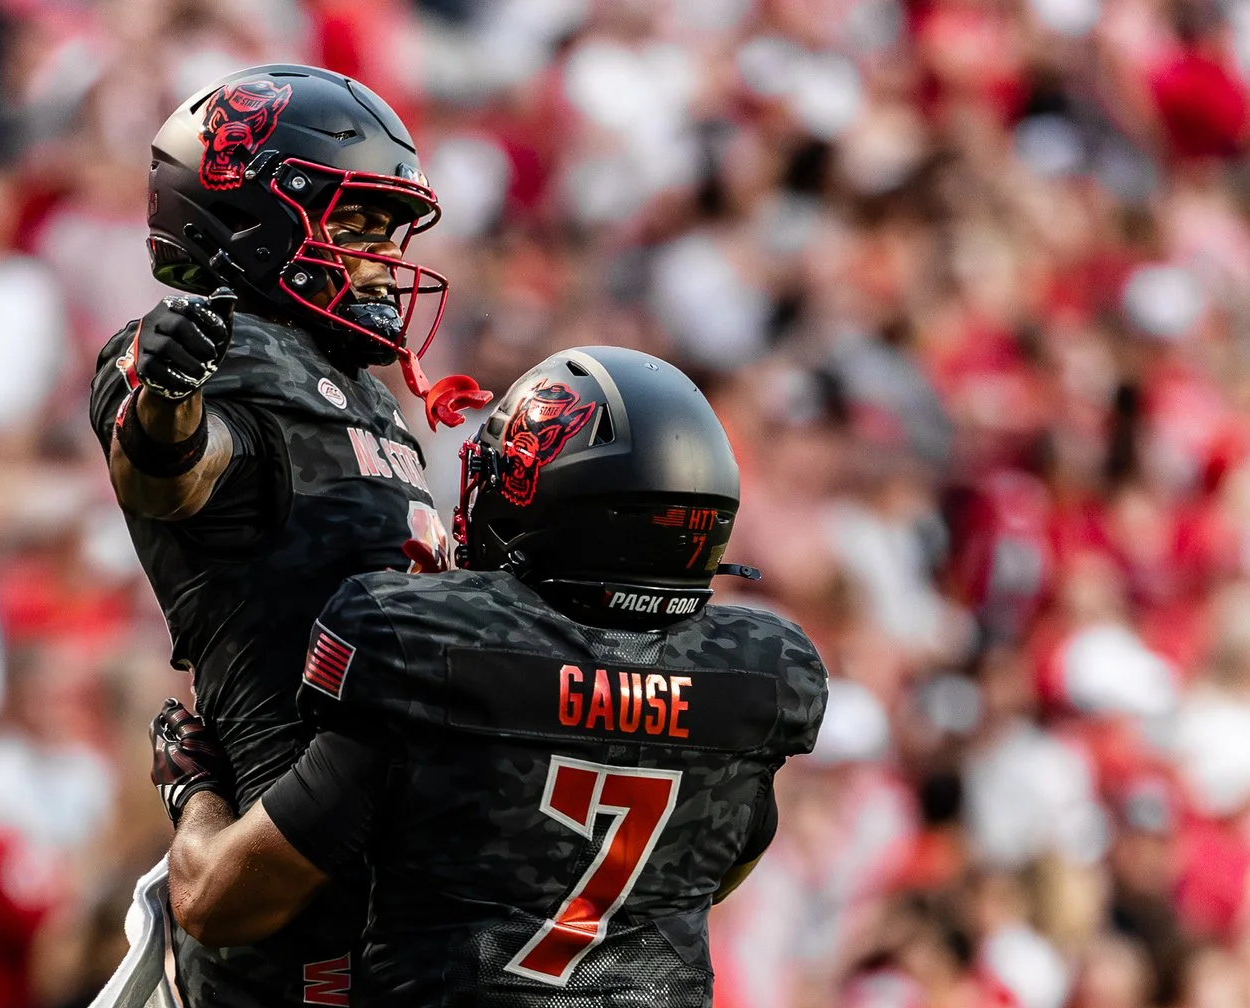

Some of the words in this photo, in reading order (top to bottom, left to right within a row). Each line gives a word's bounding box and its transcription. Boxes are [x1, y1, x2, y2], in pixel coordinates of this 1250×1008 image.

[539, 406, 560, 416] STATE
[347, 426, 393, 479] NC
[688, 509, 718, 531] HTT
[685, 534, 708, 569] 7
[608, 591, 664, 614] PACK
[665, 597, 700, 615] GOAL
[558, 664, 693, 739] GAUSE
[503, 754, 683, 988] 7
